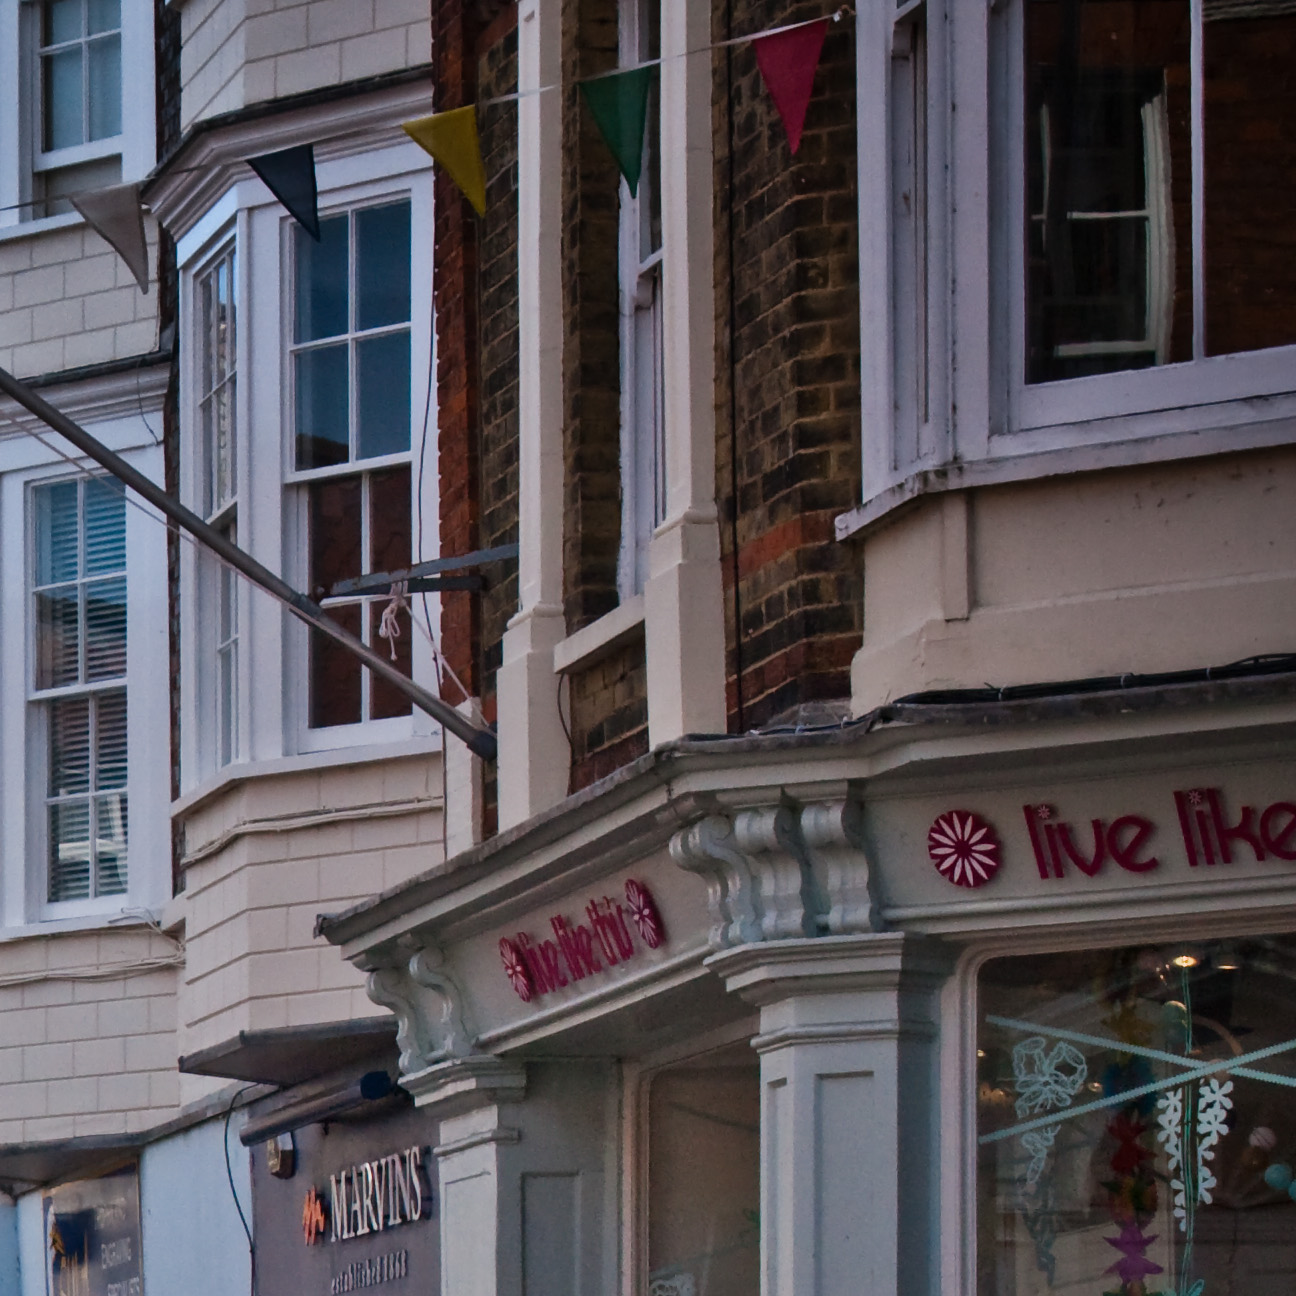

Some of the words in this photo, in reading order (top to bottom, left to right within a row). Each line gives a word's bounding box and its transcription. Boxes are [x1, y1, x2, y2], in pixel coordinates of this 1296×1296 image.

[1023, 804, 1159, 880] live
[1173, 787, 1296, 868] like
[517, 931, 568, 995] live
[550, 914, 603, 982] like
[585, 895, 635, 967] this
[329, 1145, 422, 1243] MARVINS
[331, 1255, 382, 1296] established
